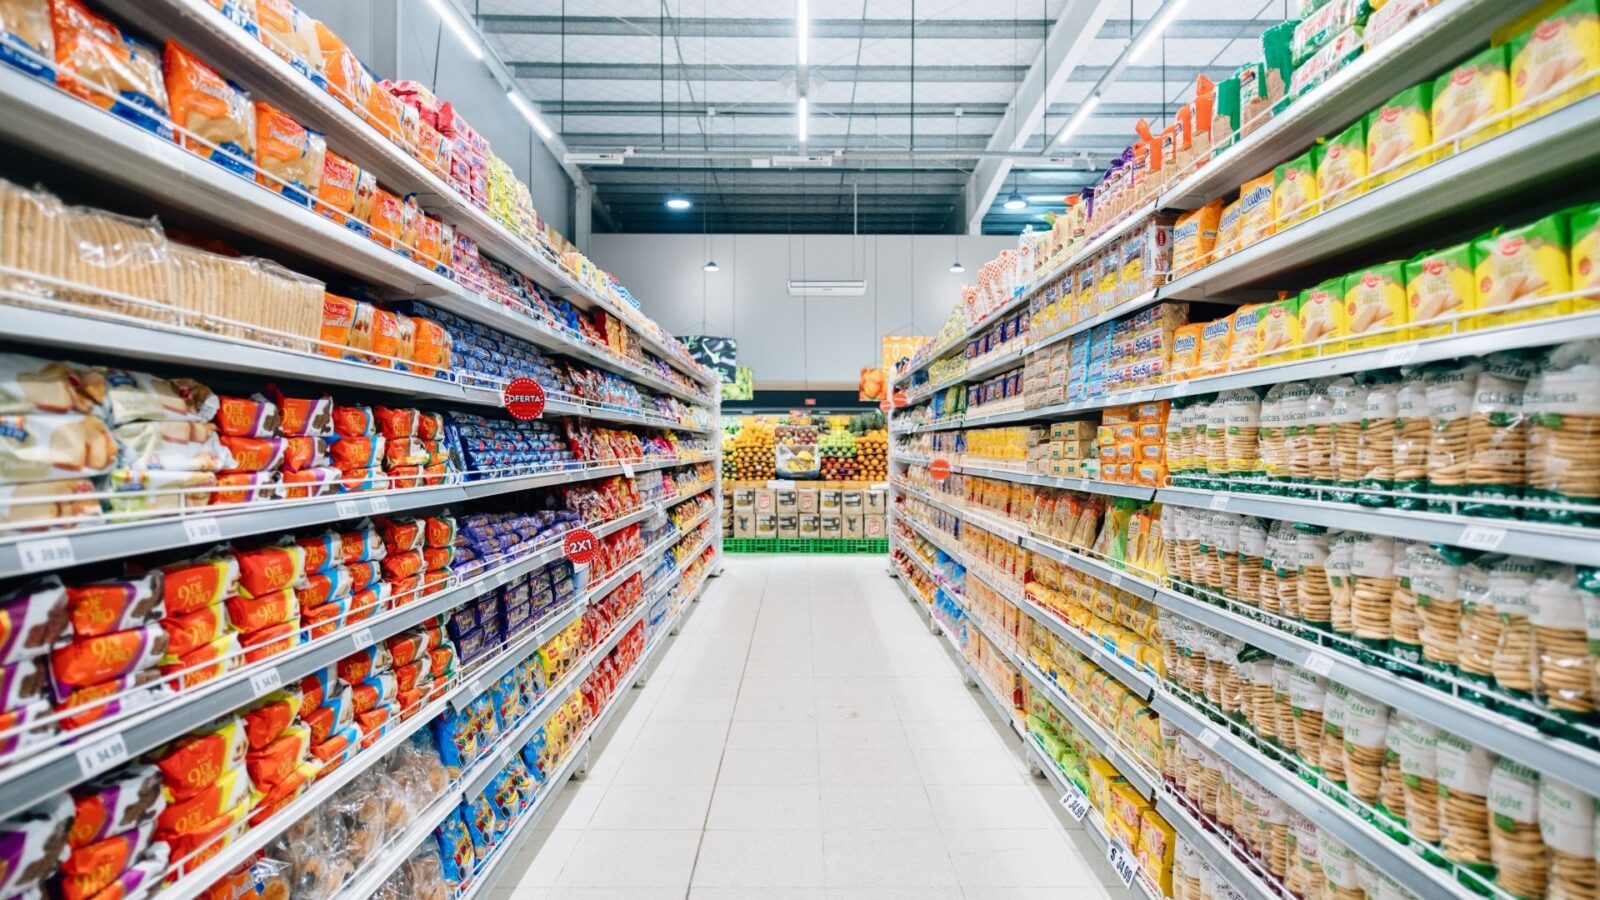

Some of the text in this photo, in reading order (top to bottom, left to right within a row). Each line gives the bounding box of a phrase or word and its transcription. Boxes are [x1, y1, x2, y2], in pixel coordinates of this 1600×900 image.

[509, 395, 541, 403] OFERTA
[569, 538, 593, 554] 2X1
[1068, 799, 1086, 819] 34.99
[1116, 855, 1133, 883] 34.99
